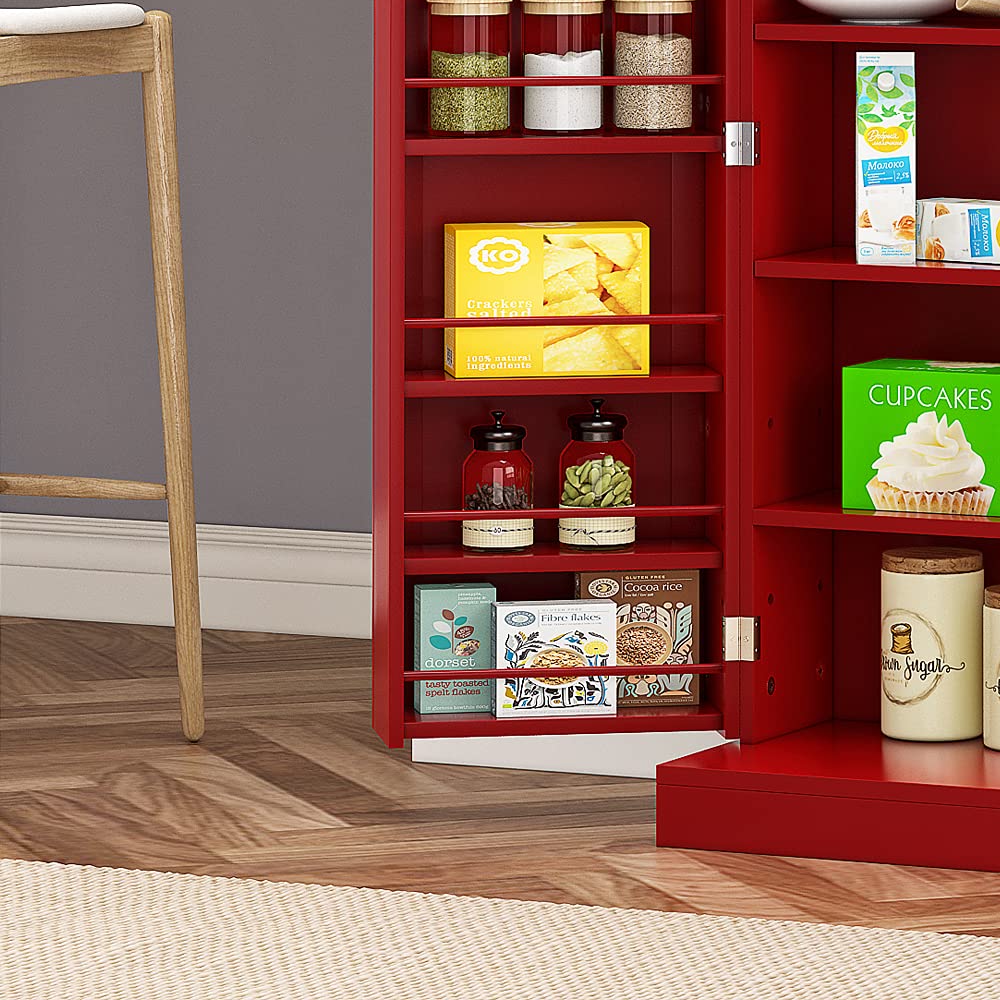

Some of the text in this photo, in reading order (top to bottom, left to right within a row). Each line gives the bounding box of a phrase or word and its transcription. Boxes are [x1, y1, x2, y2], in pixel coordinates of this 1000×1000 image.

[867, 160, 905, 170] Молоко
[981, 214, 990, 252] Молоко
[482, 249, 518, 263] KO
[467, 299, 533, 309] Crackers
[467, 353, 532, 363] 100% natural
[467, 361, 532, 372] ingredients
[868, 384, 993, 411] CUPCAKES
[624, 582, 683, 593] Cocoa rice
[541, 613, 602, 622] Fibre flakes
[424, 657, 476, 668] dorset
[904, 656, 943, 681] Sugar
[425, 679, 489, 689] tasty toasted
[425, 688, 481, 698] spelt flakes
